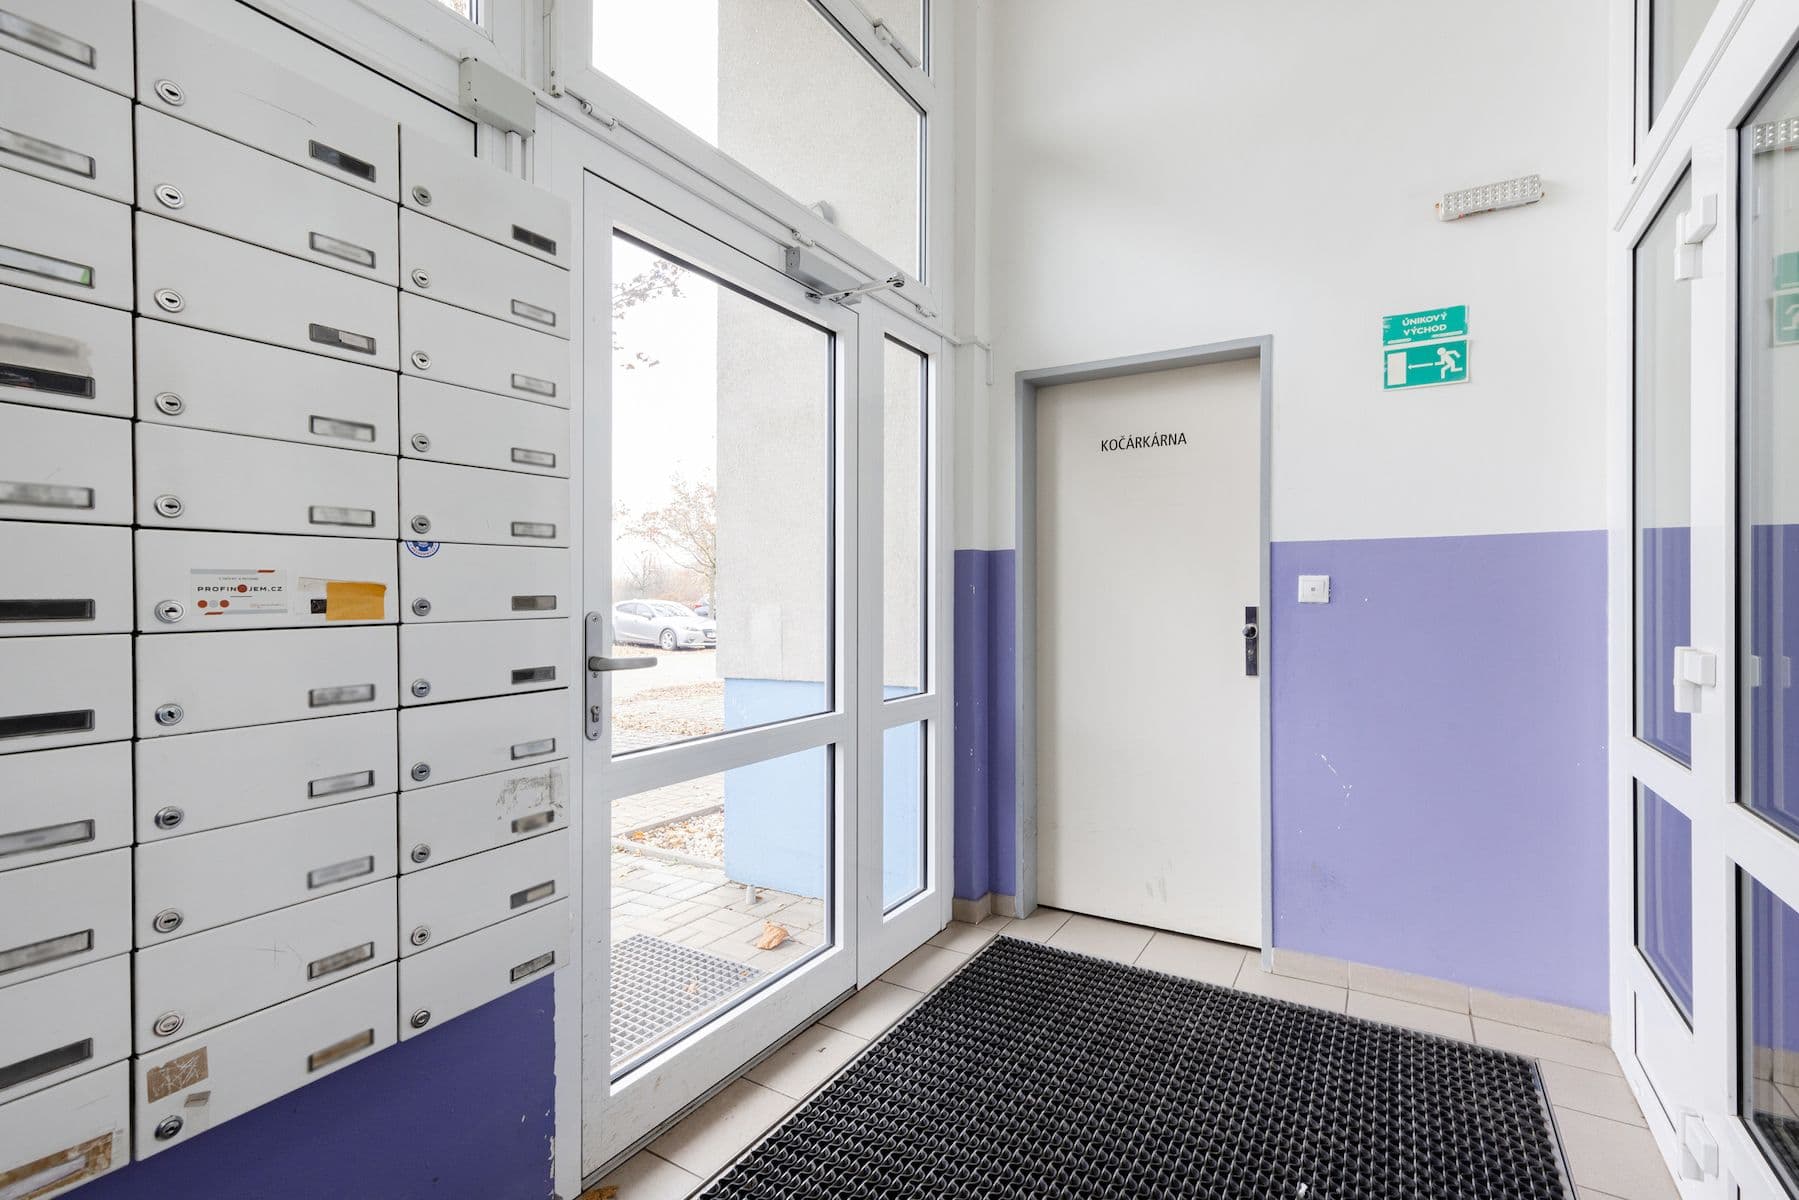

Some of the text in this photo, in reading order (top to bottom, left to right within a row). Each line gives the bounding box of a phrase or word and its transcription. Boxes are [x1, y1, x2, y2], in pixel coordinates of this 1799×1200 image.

[1402, 312, 1447, 326] ÚNIKOVÝ
[1403, 324, 1447, 336] VÝCHOD
[1101, 432, 1187, 452] KOČÁRKÁRNA
